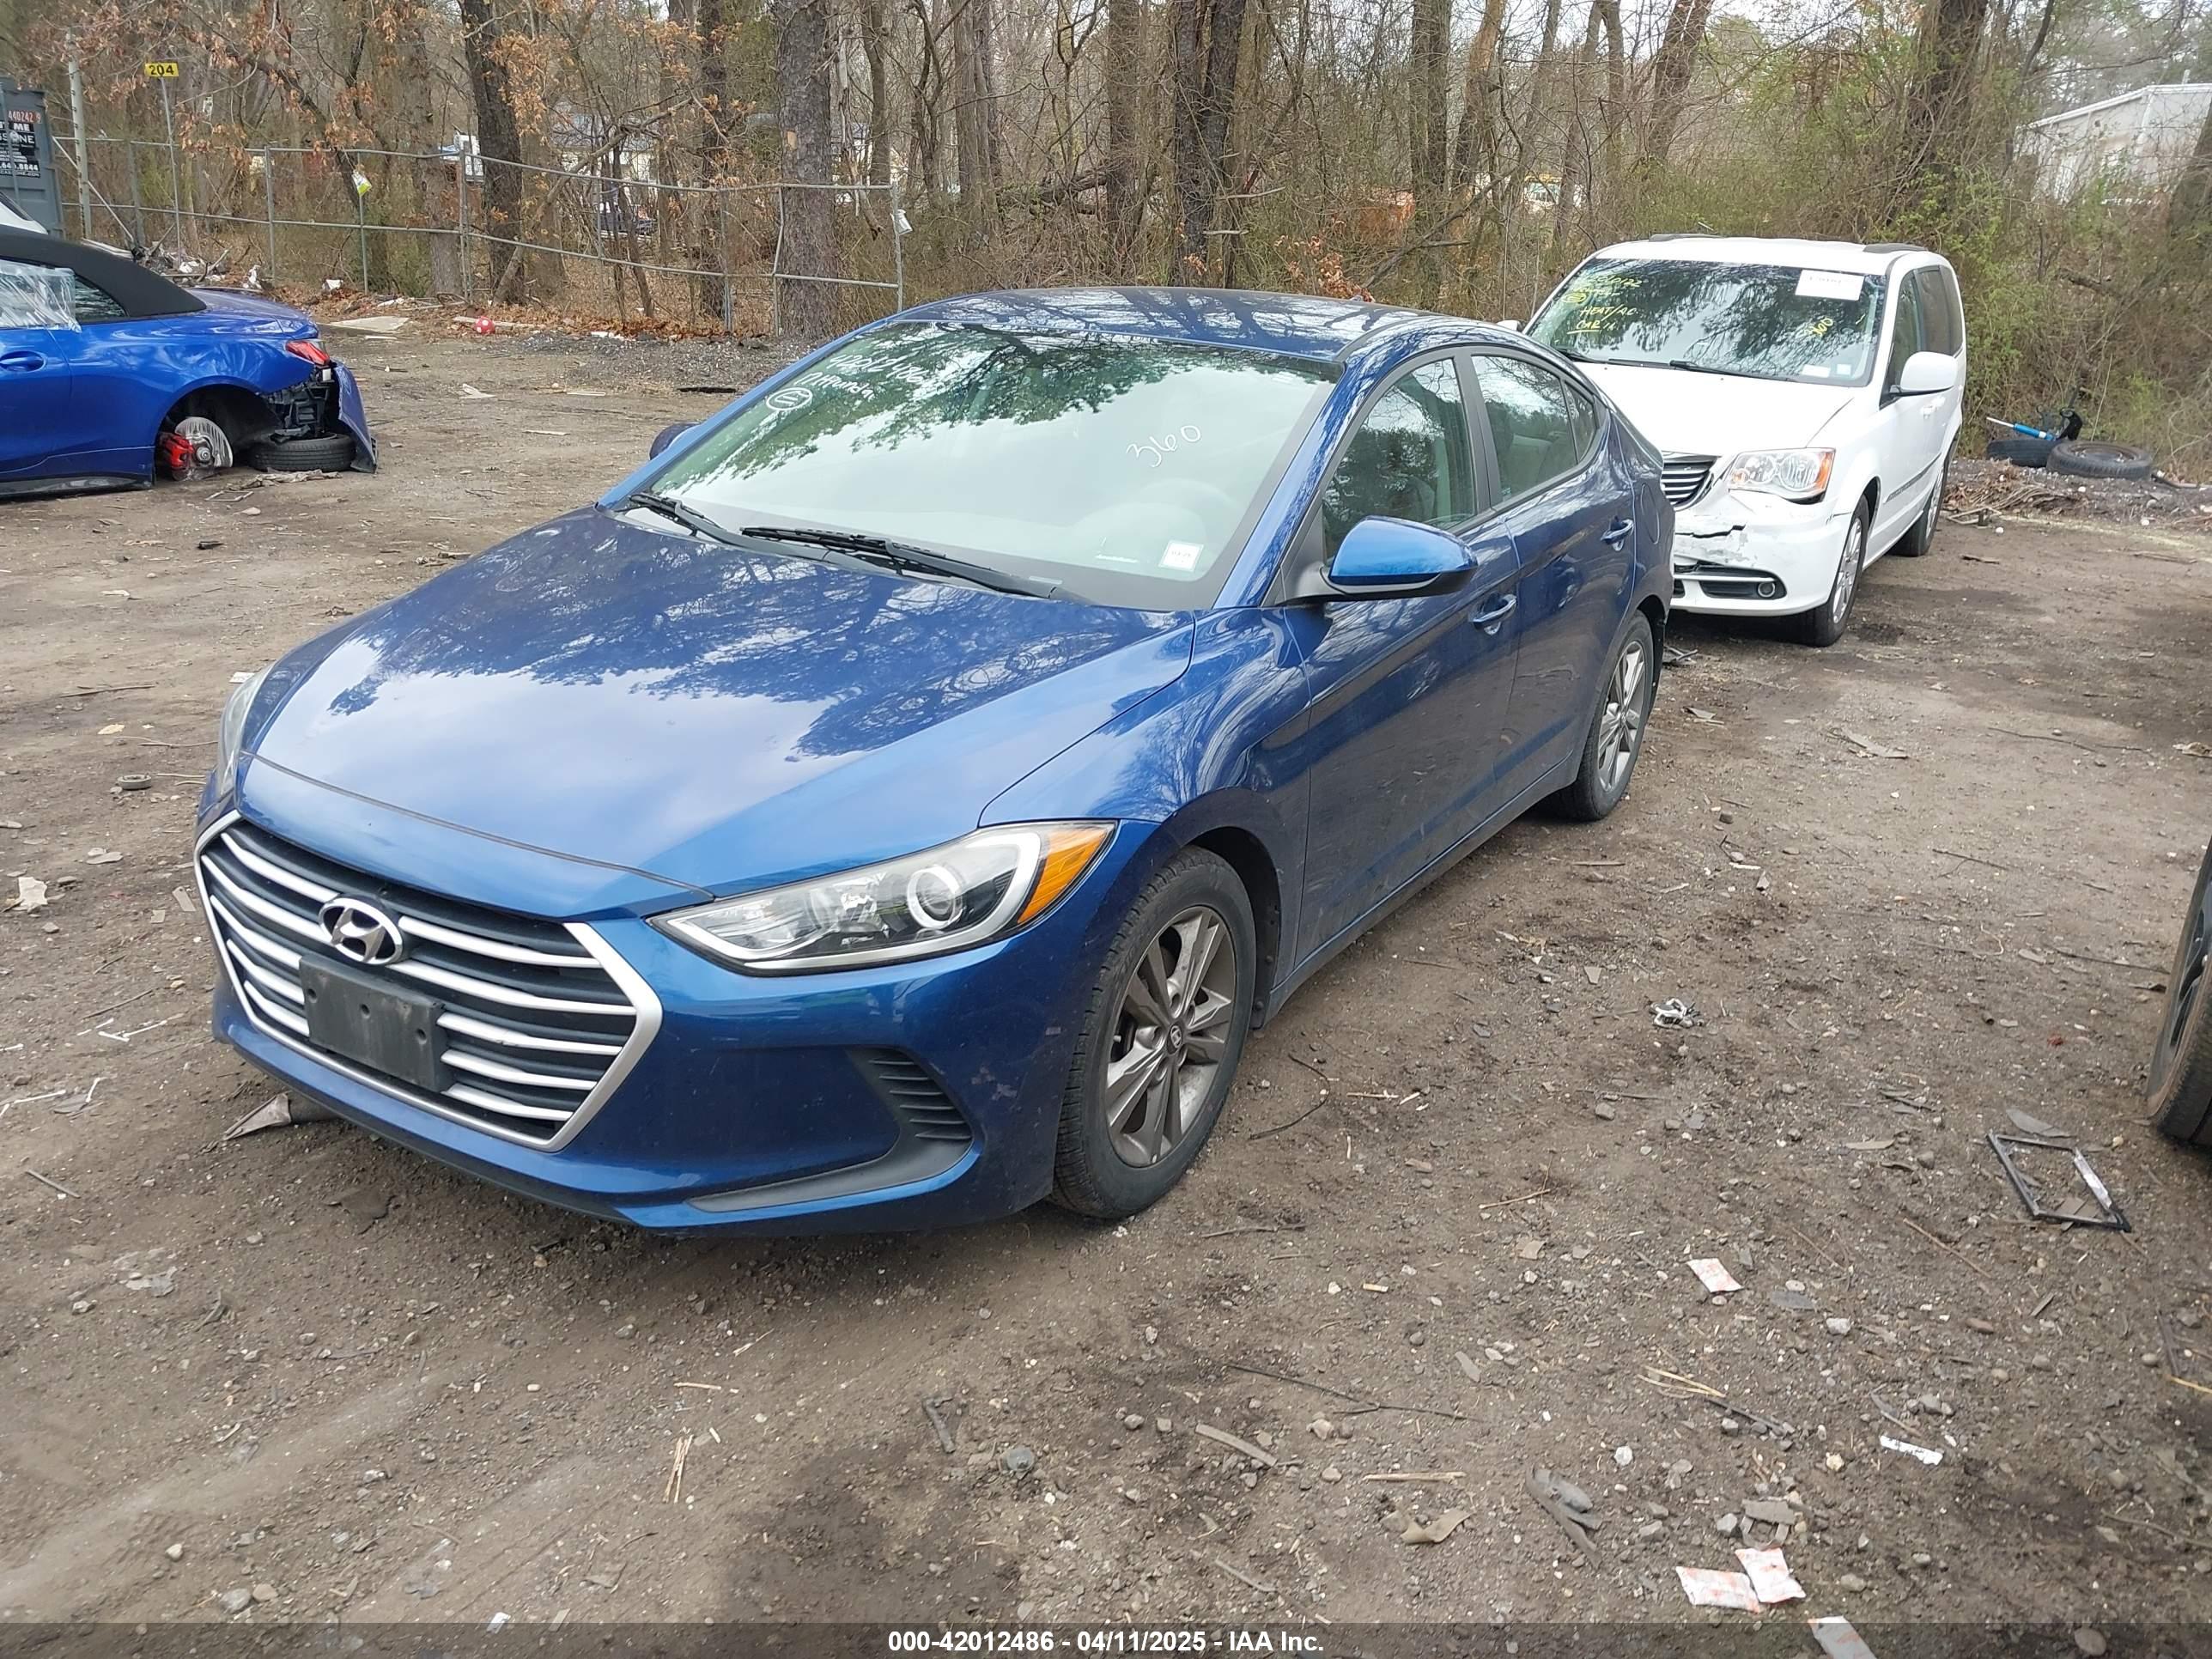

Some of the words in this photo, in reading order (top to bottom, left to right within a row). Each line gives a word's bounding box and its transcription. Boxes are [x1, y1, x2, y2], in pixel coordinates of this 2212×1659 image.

[149, 64, 174, 76] 204
[13, 123, 30, 131] ME
[1576, 319, 1601, 330] CAR
[1126, 424, 1201, 468] 360
